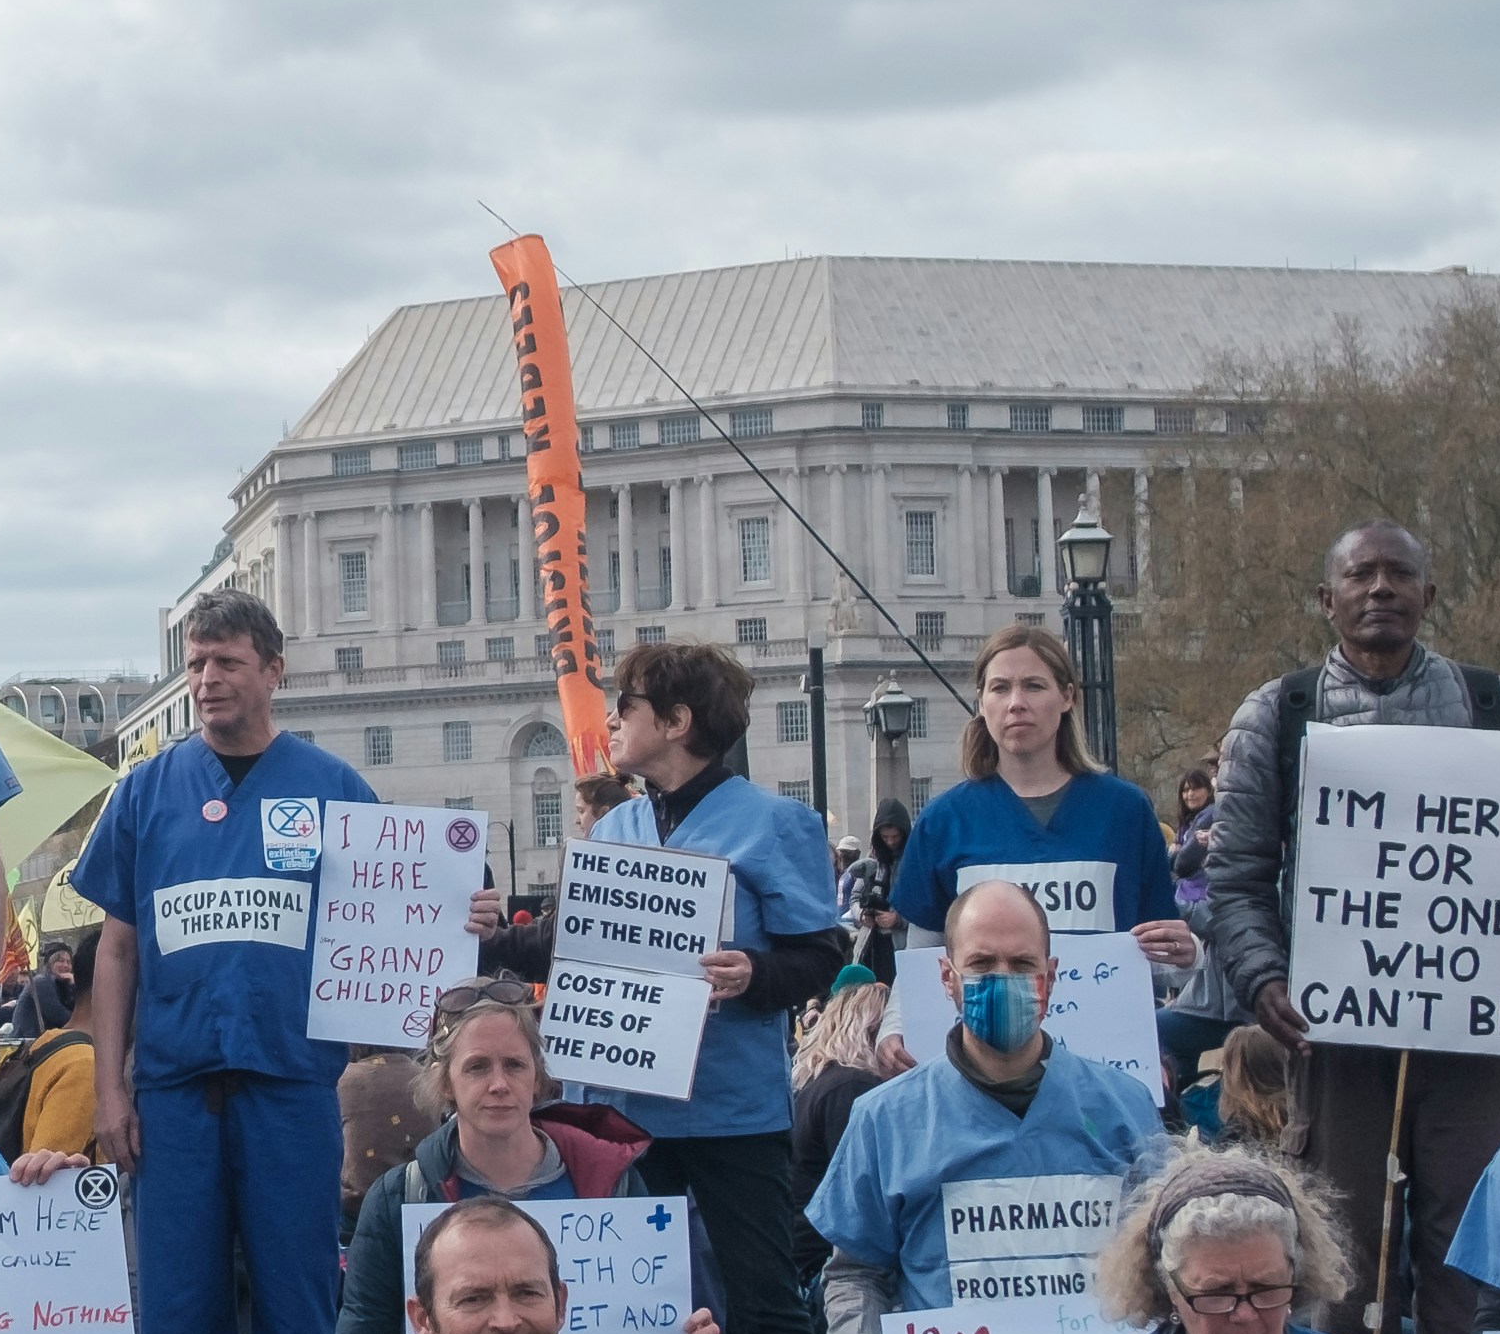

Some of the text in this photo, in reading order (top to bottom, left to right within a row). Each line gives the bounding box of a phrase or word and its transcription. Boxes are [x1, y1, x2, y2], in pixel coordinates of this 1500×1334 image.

[1315, 786, 1386, 830] I'M
[340, 814, 425, 853] I AM
[352, 860, 428, 890] HERE
[572, 852, 707, 888] THE CARBON
[1376, 841, 1473, 885] FOR
[161, 889, 303, 918] OCCUPATIONAL
[327, 900, 442, 924] FOR MY
[568, 882, 697, 918] EMISSIONS
[1308, 886, 1401, 929] THE
[181, 911, 280, 936] THERAPIST
[565, 916, 706, 954] OF THE RICH
[330, 945, 444, 976] GRAND
[1361, 939, 1479, 982] WHO
[557, 972, 664, 1005] COST THE
[549, 1003, 651, 1034] LIVES OF
[1301, 981, 1443, 1031] CAN'T
[544, 1035, 656, 1069] THE POOR
[560, 1211, 622, 1244] FOR
[951, 1200, 1113, 1234] PHARMACIST
[631, 1255, 668, 1284] OF
[956, 1272, 1085, 1299] PROTESTING
[622, 1303, 677, 1331] AND
